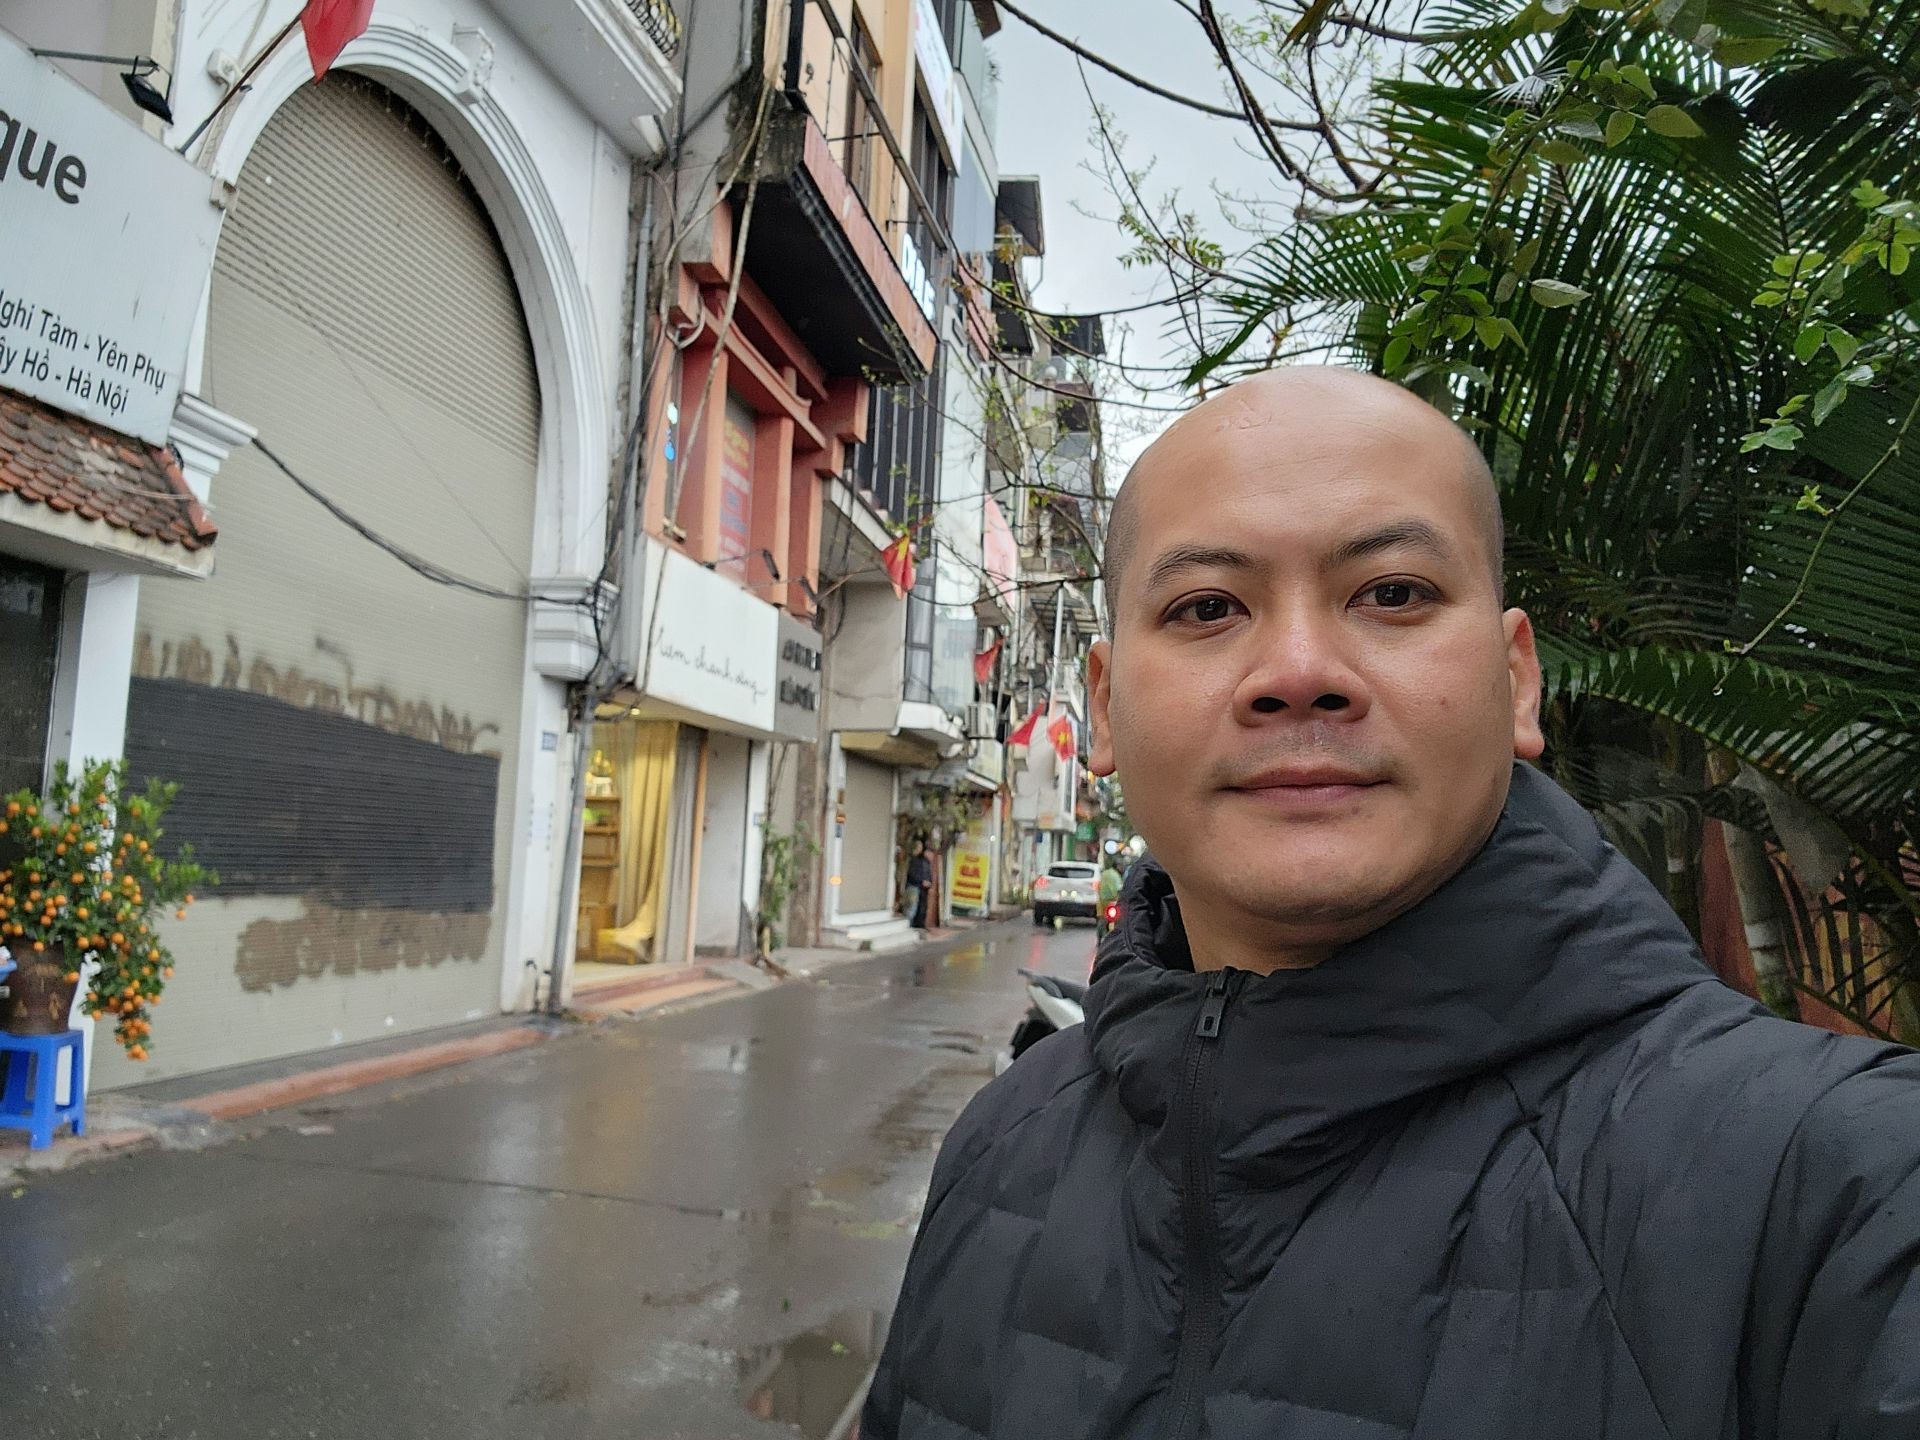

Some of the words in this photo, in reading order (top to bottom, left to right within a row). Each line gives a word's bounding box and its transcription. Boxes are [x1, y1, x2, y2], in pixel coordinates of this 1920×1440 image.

[0, 110, 87, 204] que
[0, 289, 35, 330] ghi
[97, 334, 129, 373] Yên
[132, 353, 166, 395] Phụ
[21, 347, 50, 381] Hồ
[66, 365, 92, 399] Hà
[96, 378, 129, 417] Nội
